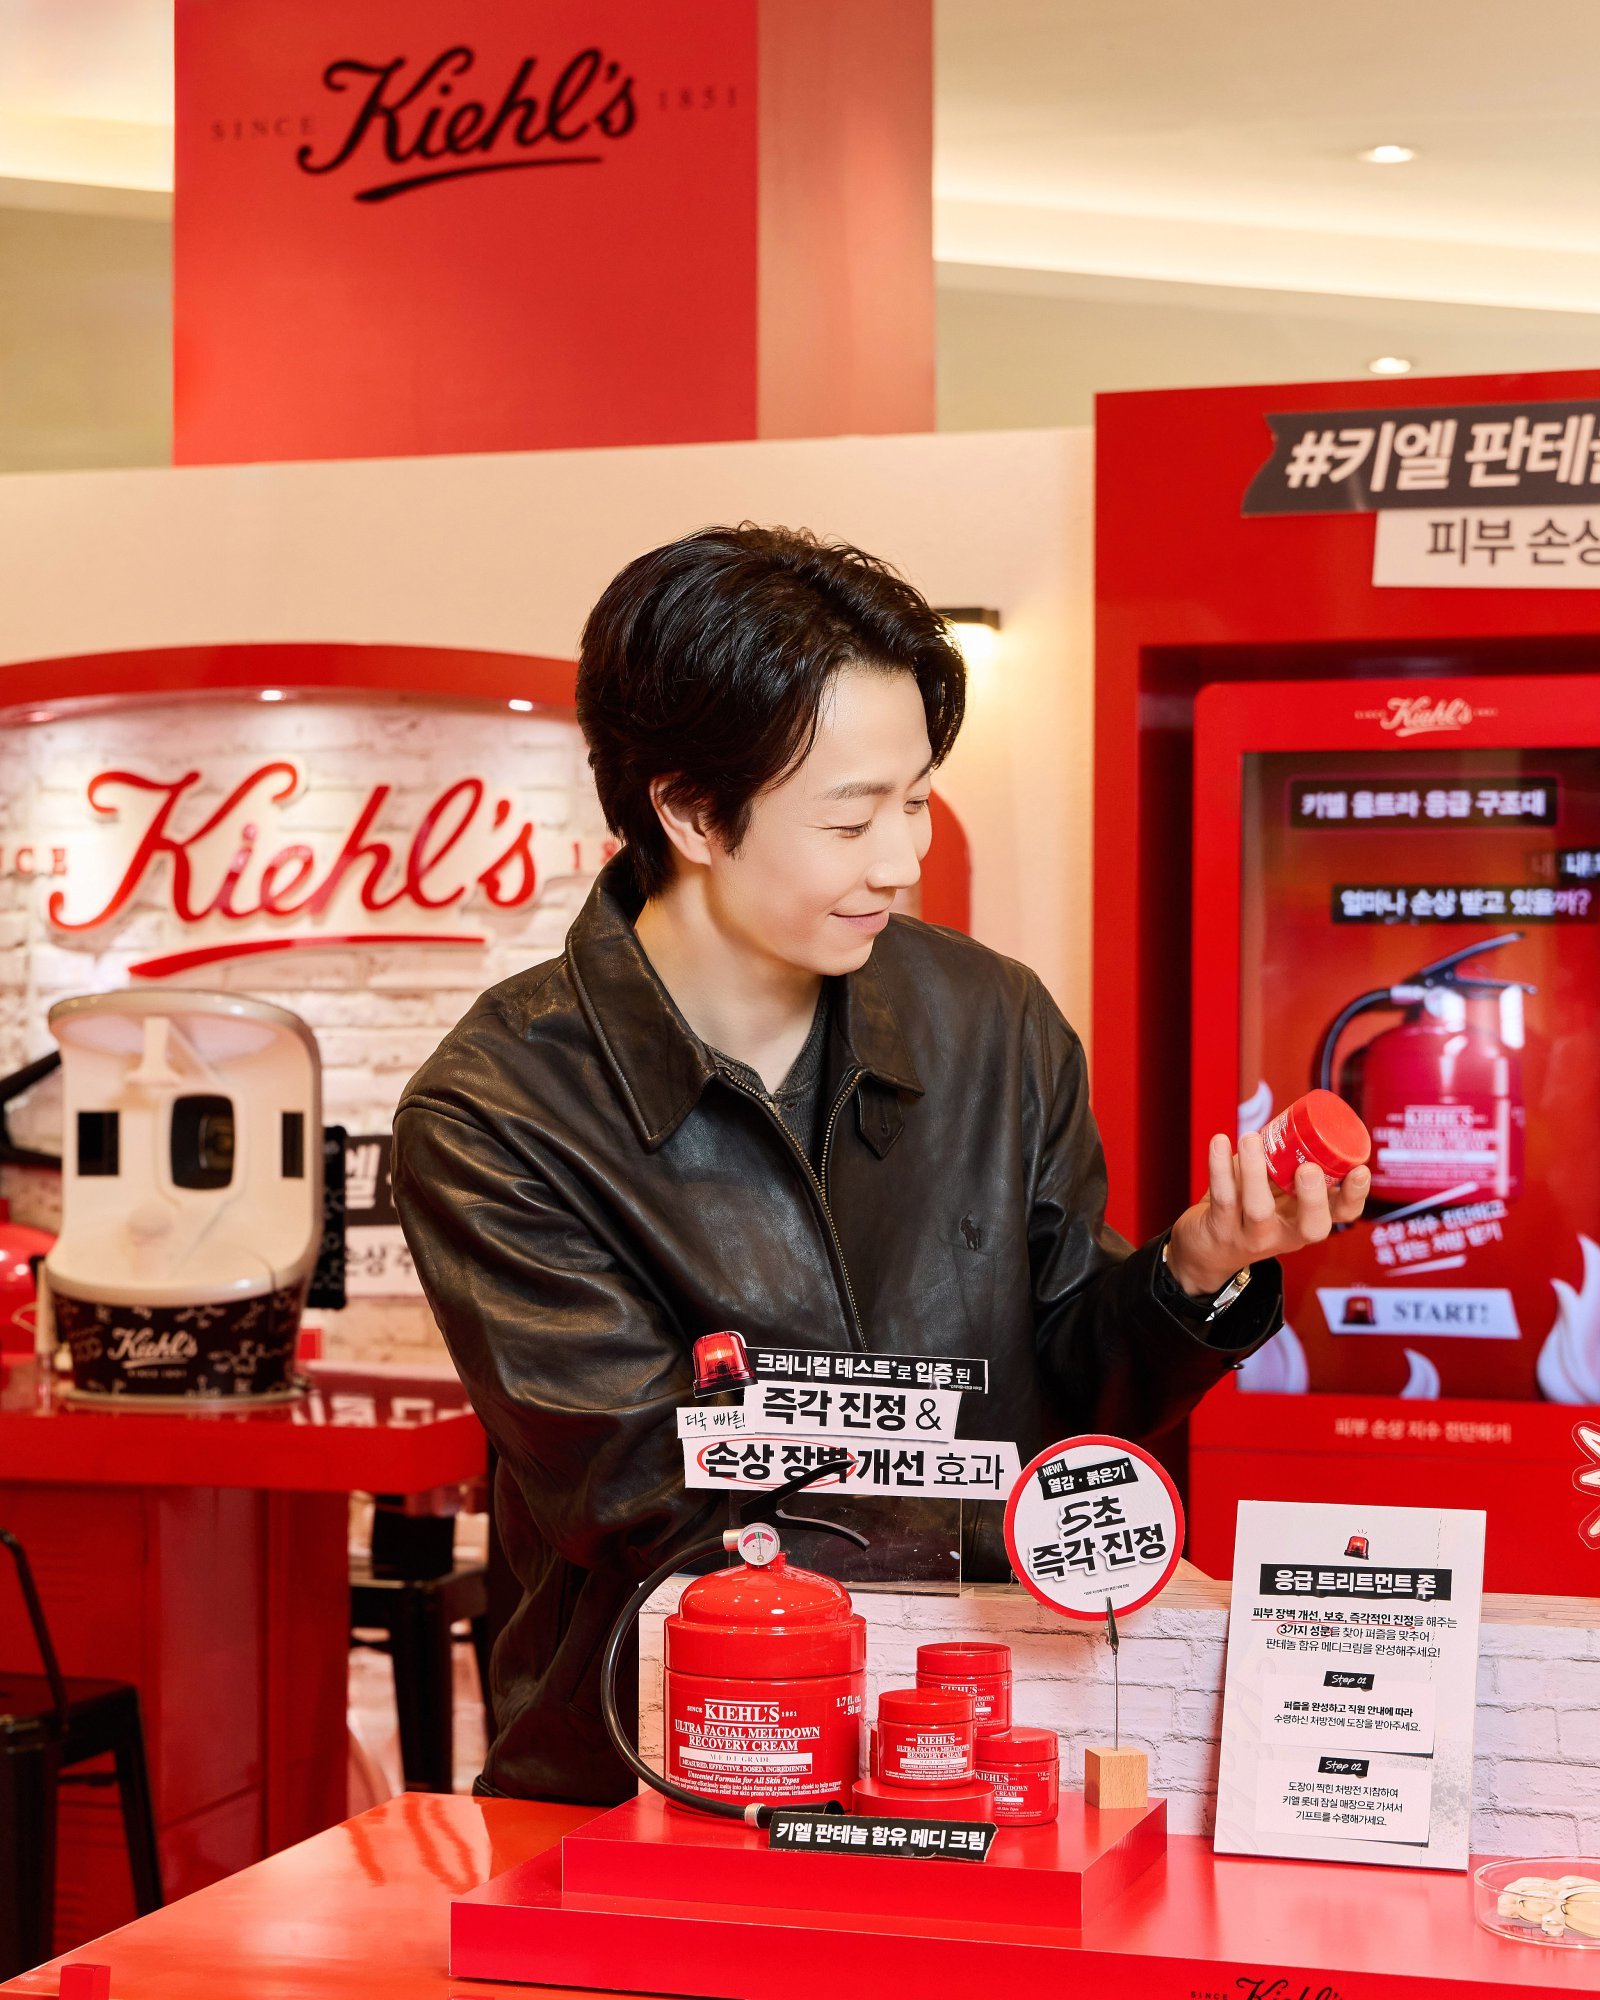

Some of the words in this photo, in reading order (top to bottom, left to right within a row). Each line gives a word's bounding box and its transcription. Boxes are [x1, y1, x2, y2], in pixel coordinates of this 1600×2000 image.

[297, 47, 638, 175] Kiehl's
[1285, 418, 1458, 492] #키엘
[1426, 518, 1515, 567] 피부
[1380, 696, 1473, 731] Kiehl's
[49, 762, 536, 932] Kiehl's
[1392, 1302, 1489, 1325] START!
[756, 1353, 831, 1377] 크리니컬
[762, 1387, 833, 1427] 즉각
[838, 1392, 907, 1431] 진정
[915, 1398, 942, 1431] &
[706, 1442, 775, 1480] 손상
[856, 1448, 925, 1486] 개선
[933, 1452, 1005, 1490] 효과
[1042, 1464, 1064, 1477] NEW!
[1048, 1475, 1075, 1494] 열감
[1033, 1537, 1096, 1578] 즉각
[1102, 1523, 1167, 1566] 진정
[1274, 1569, 1313, 1591] 응급
[1316, 1571, 1414, 1594] 트리트먼트
[1416, 1574, 1437, 1595] 존
[1253, 1607, 1274, 1619] 피부
[1275, 1608, 1296, 1620] 장벽
[1298, 1610, 1322, 1622] 개선,
[1323, 1611, 1348, 1623] 보호,
[1350, 1612, 1392, 1625] 즉각적인
[1393, 1614, 1425, 1627] 진정을
[1426, 1616, 1459, 1629] 해주는
[1280, 1624, 1308, 1636] 3가지
[1310, 1625, 1341, 1638] 성분을
[1342, 1627, 1364, 1639] 찾아
[1365, 1628, 1397, 1641] 퍼즐을
[1399, 1630, 1431, 1642] 맞추어
[1266, 1638, 1297, 1651] 판테놀
[1298, 1640, 1320, 1652] 함유
[1321, 1641, 1373, 1655] 메디크림을
[1375, 1643, 1441, 1658] 완성해주세요!
[704, 1703, 780, 1723] KIEHL'S
[1284, 1700, 1310, 1711] 퍼즐을
[1311, 1702, 1347, 1713] 완성하고
[1347, 1704, 1366, 1715] 직원
[1367, 1705, 1394, 1717] 안내에
[1395, 1707, 1414, 1718] 따라
[674, 1719, 703, 1735] ULTRA
[703, 1724, 747, 1739] FACIAL
[747, 1726, 821, 1739] MELTDOWN
[1273, 1713, 1309, 1725] 수령하신
[1310, 1716, 1346, 1727] 처방전에
[1346, 1718, 1374, 1729] 도장을
[1375, 1719, 1421, 1732] 받아주세요.
[688, 1735, 749, 1751] RECOVERY
[751, 1740, 799, 1752] CREAM
[917, 1735, 956, 1745] KIEHL'S
[1350, 1762, 1363, 1771] 02
[688, 1770, 714, 1781] Unscented
[714, 1774, 742, 1783] Formula
[741, 1776, 753, 1785] for
[782, 1776, 800, 1785] Types
[975, 1771, 1009, 1783] KIEHL'S
[1288, 1781, 1315, 1793] 도장이
[1316, 1783, 1334, 1795] 찍힌
[1335, 1785, 1362, 1796] 처방전
[1363, 1787, 1399, 1798] 지참하여
[1282, 1795, 1301, 1806] 키엘
[1301, 1796, 1319, 1807] 롯데
[1320, 1797, 1339, 1809] 잠실
[1339, 1799, 1375, 1811] 매장으로
[1376, 1801, 1403, 1813] 가셔서
[1295, 1810, 1331, 1823] 기프트를
[1332, 1812, 1387, 1826] 수령해가세요.
[776, 1822, 813, 1842] 키엘
[815, 1823, 869, 1845] 판테놀
[871, 1826, 909, 1847] 함유
[910, 1829, 946, 1849] 메디
[949, 1831, 986, 1851] 크림
